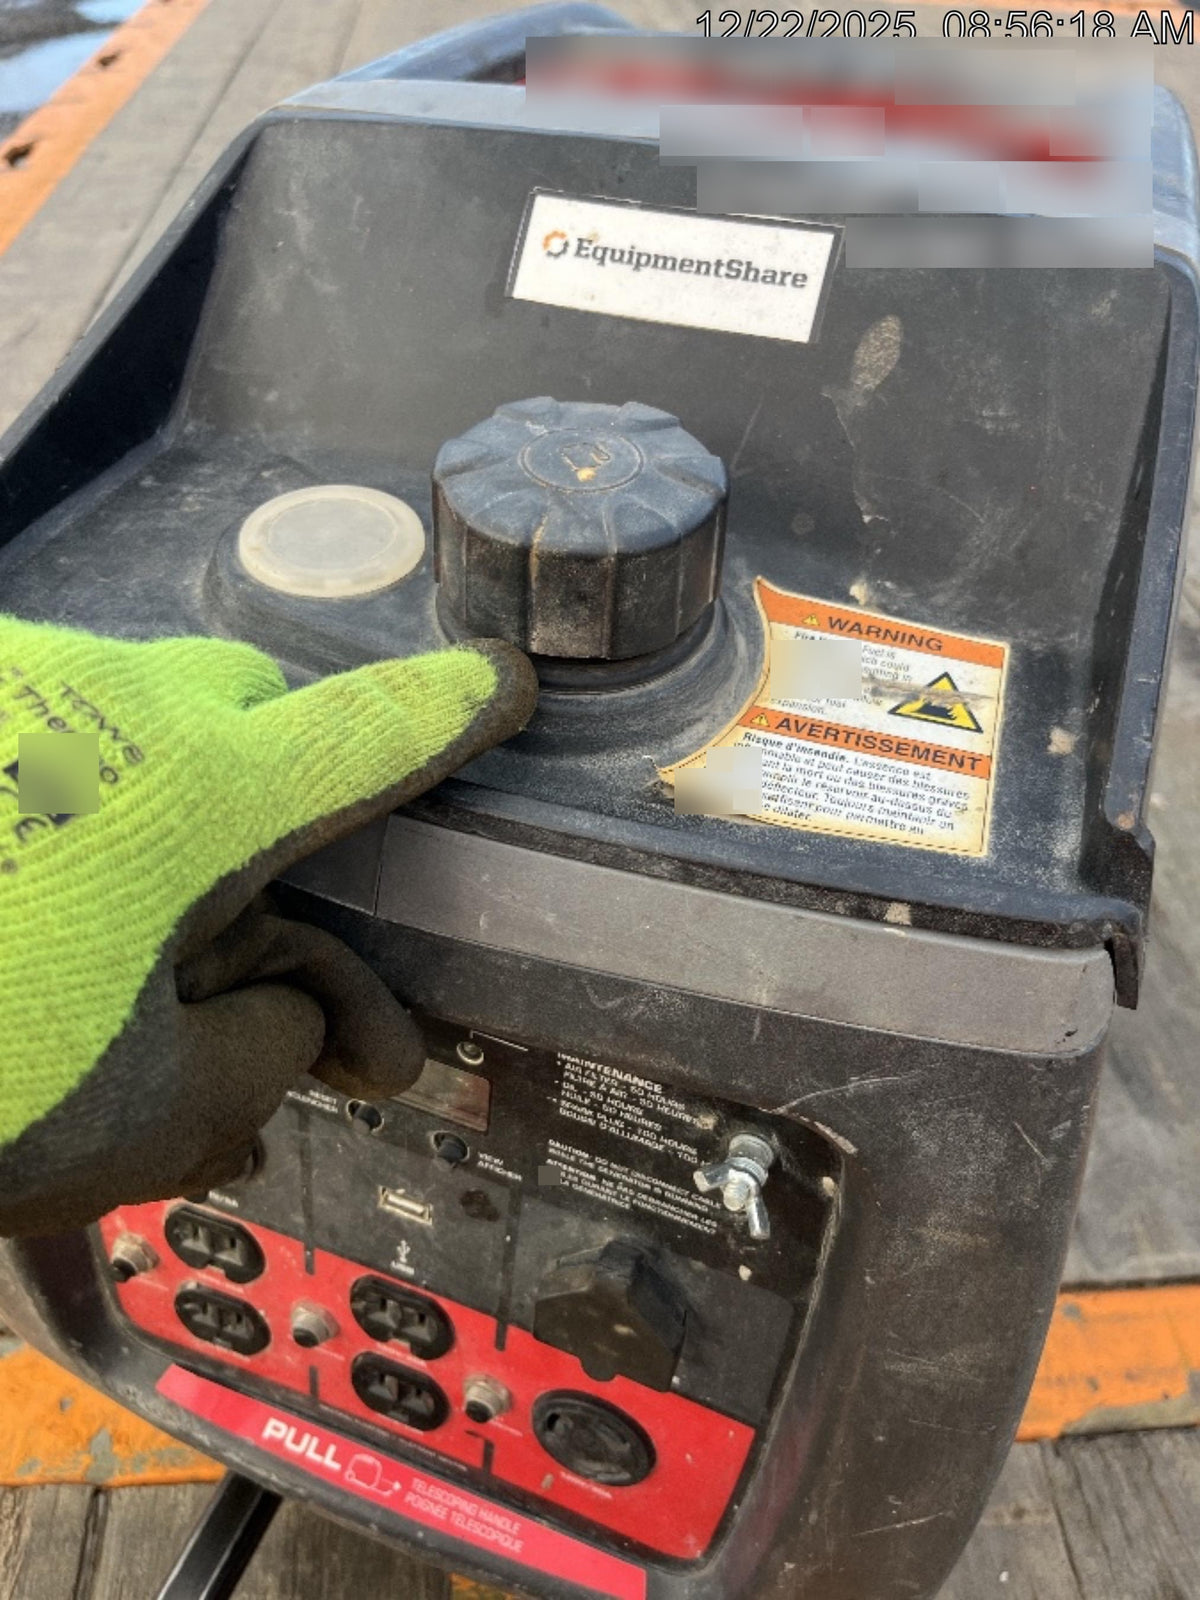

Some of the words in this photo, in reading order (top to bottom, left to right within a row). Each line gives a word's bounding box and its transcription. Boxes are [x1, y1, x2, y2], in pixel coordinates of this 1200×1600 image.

[574, 237, 808, 288] EquipmentShare
[827, 616, 943, 651] WARNING
[742, 732, 783, 751] Risque
[785, 741, 850, 762] d'incendie.
[776, 717, 982, 771] AVERTISSEMENT
[262, 1417, 341, 1471] PULL
